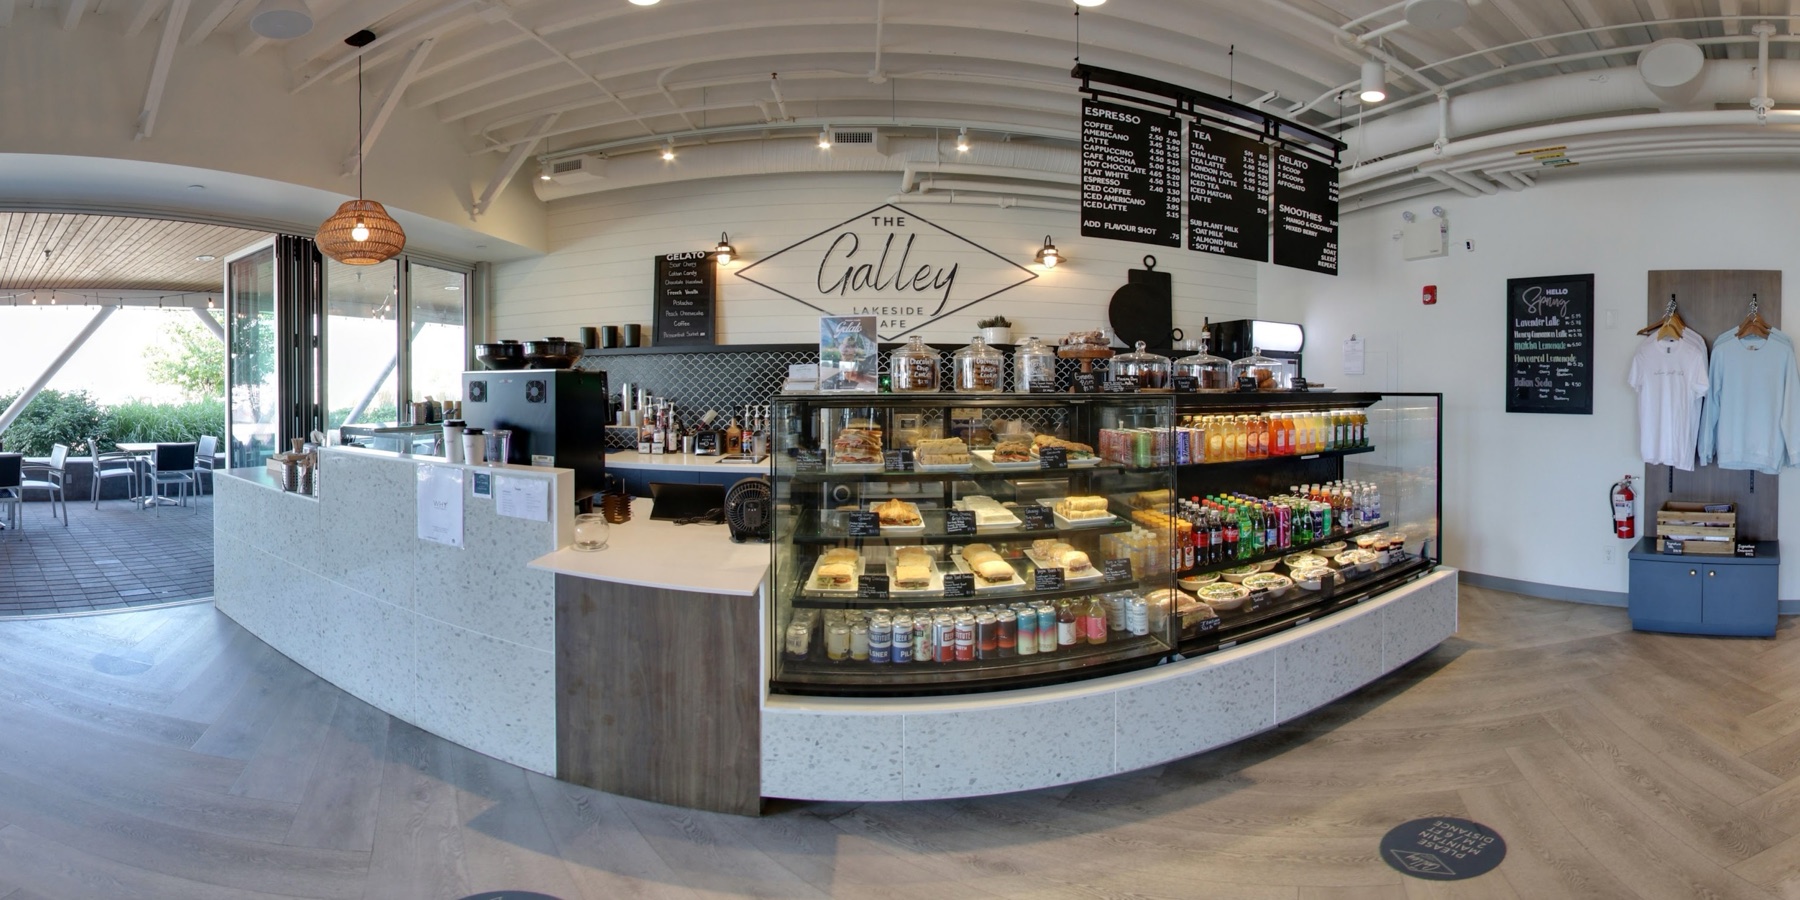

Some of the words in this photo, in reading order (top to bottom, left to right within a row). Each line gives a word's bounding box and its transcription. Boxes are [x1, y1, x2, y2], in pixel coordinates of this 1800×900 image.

[1084, 107, 1141, 124] ESPRESSO
[1084, 121, 1114, 131] COFFEE
[1166, 137, 1180, 145] 2.90
[1193, 130, 1211, 141] TEA
[1084, 129, 1129, 141] AMERICANO
[1149, 140, 1162, 148] 3.45
[1166, 144, 1179, 152] 3.95
[1191, 142, 1204, 150] TEA
[1084, 136, 1109, 146] LATTE
[1167, 151, 1179, 159] 5.15
[1084, 144, 1133, 157] CAPPUCCINO
[1149, 155, 1164, 163] 4.50
[1167, 158, 1179, 166] 5.15
[1084, 152, 1103, 161] CAFE
[1107, 155, 1136, 165] MOCHA
[1149, 162, 1164, 170] 5.00
[1190, 150, 1206, 159] CHAI
[1207, 153, 1226, 164] LATTE
[1191, 157, 1206, 166] TEA
[1205, 159, 1224, 170] LATTE
[1279, 154, 1308, 170] GELATO
[1084, 160, 1100, 168] HOT
[1101, 162, 1146, 175] CHOCOLATE
[1149, 170, 1162, 178] 4.65
[1084, 168, 1102, 176] FLAT
[1105, 170, 1129, 179] WHITE
[1191, 164, 1218, 176] LONDON
[1220, 170, 1232, 179] FOG
[1282, 165, 1301, 175] SCOOP
[1190, 171, 1216, 183] MATCHA
[1218, 177, 1237, 188] LATTE
[1190, 179, 1206, 188] ICED
[1207, 182, 1220, 191] TEA
[1282, 173, 1304, 184] SCOOPS
[1084, 176, 1120, 186] ESPRESSO
[1149, 185, 1163, 193] 2.40
[1167, 188, 1180, 196] 3.30
[1084, 184, 1101, 192] ICED
[1103, 186, 1131, 196] COFFEE
[1277, 180, 1306, 192] AFFOGATO
[1190, 186, 1206, 195] ICED
[1207, 189, 1232, 200] MATCHA
[1191, 194, 1212, 204] LATTE
[1084, 192, 1102, 200] ICED
[1103, 194, 1146, 206] AMERICANO
[1166, 203, 1179, 211] 3.95
[1103, 203, 1128, 212] LATTE
[1279, 204, 1322, 223] SMOOTHIES
[871, 216, 905, 227] THE
[1084, 220, 1100, 228] ADD
[1105, 223, 1136, 232] FLAVOUR
[1138, 226, 1156, 235] SHOT
[1190, 219, 1202, 227] SUB
[1203, 221, 1223, 230] PLANT
[1224, 225, 1239, 233] MILK
[1310, 222, 1333, 233] COCONUT
[1209, 230, 1223, 238] MILK
[1303, 229, 1318, 237] BERRY
[1224, 240, 1238, 248] MILK
[666, 251, 705, 261] GELATO
[817, 232, 958, 318] Galley
[1522, 286, 1570, 317] Spring
[852, 306, 924, 316] LAKESIDE
[880, 319, 906, 329] AFE
[1515, 317, 1545, 327] Lavender
[1545, 316, 1560, 326] Latte
[835, 321, 862, 338] Gelato
[1538, 341, 1566, 350] Lemonade
[1514, 354, 1545, 362] Flavoured
[1546, 353, 1576, 362] Lemonade
[1514, 378, 1533, 387] Italian
[1535, 377, 1552, 387] Soda
[1433, 821, 1495, 844] DISTANCE
[1417, 838, 1466, 859] PLEASE
[1418, 831, 1481, 855] MAINTAIN
